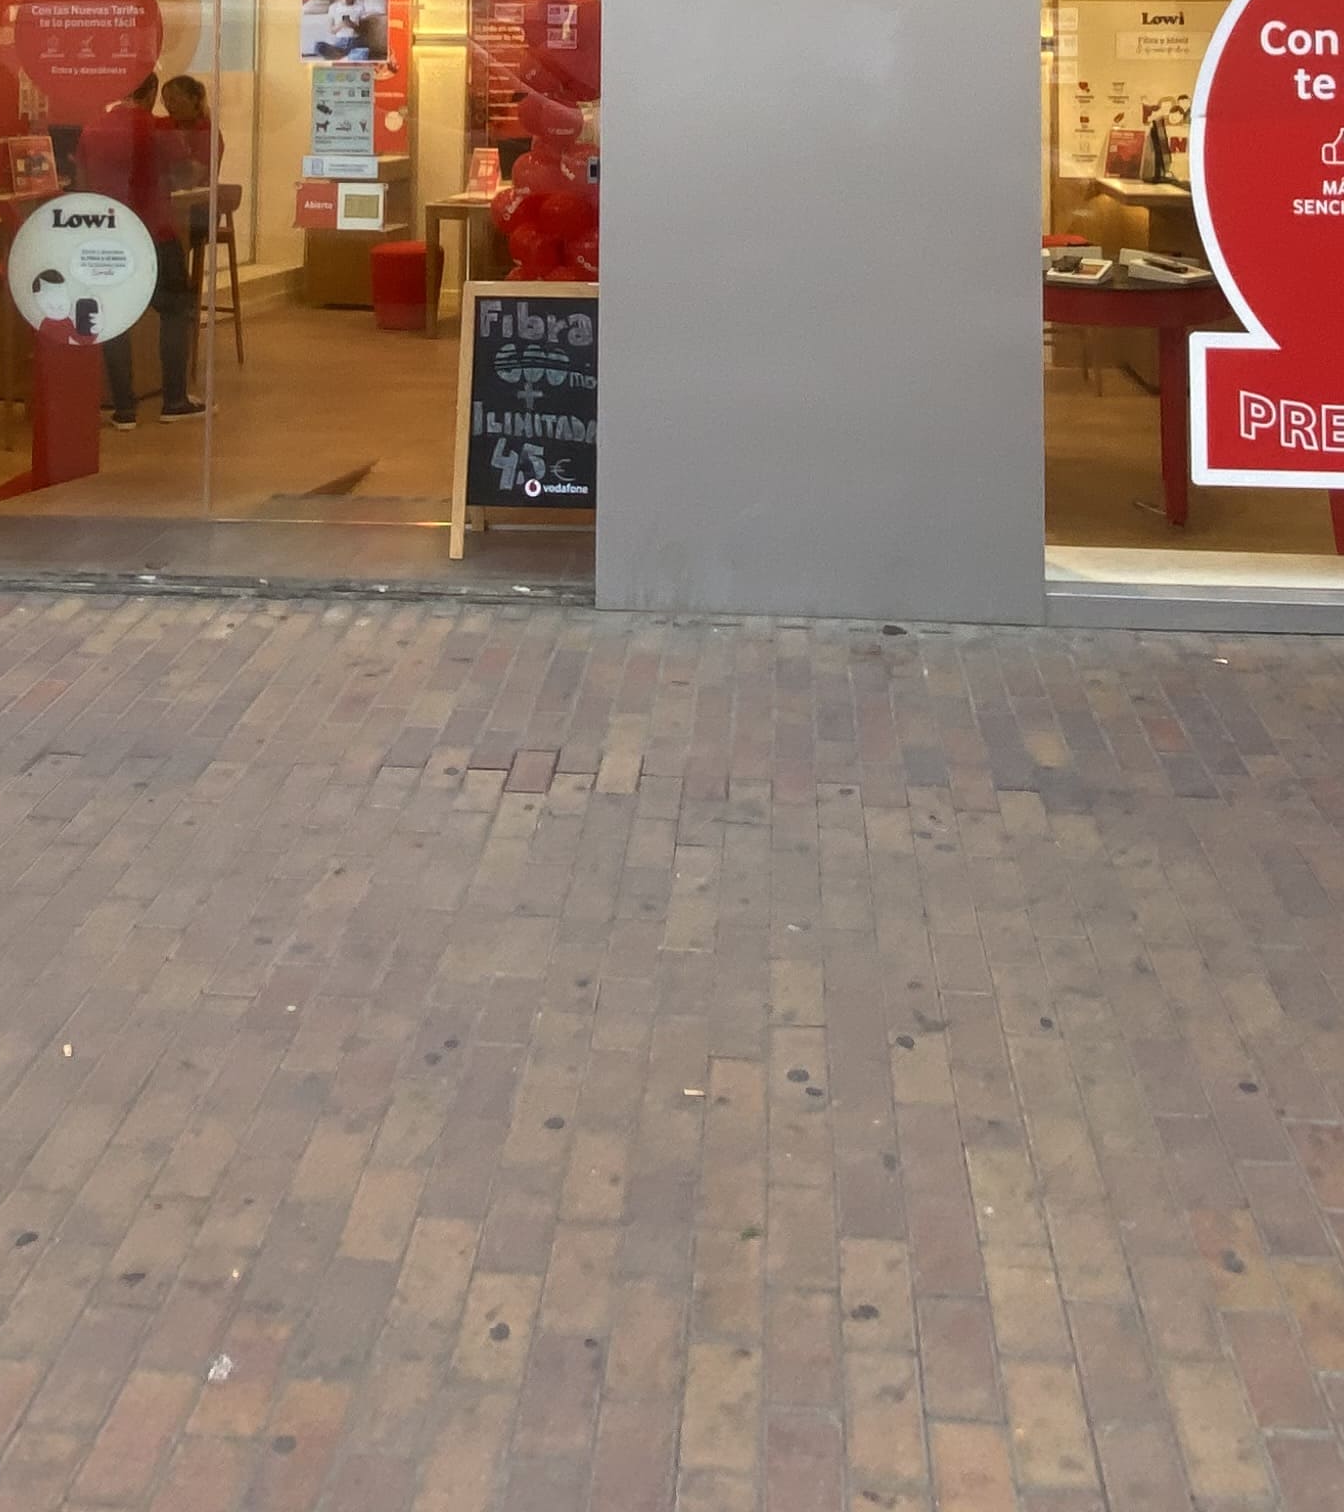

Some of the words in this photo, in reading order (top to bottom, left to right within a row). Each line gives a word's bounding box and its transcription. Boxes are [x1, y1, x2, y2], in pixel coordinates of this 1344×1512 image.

[71, 5, 109, 15] Nuevas
[64, 19, 112, 30] ponemos
[1142, 12, 1185, 26] Lowi
[1259, 21, 1339, 56] Con
[1294, 70, 1335, 101] te
[52, 208, 116, 229] Lowi
[479, 300, 593, 346] Fibra
[543, 482, 589, 495] vodafone
